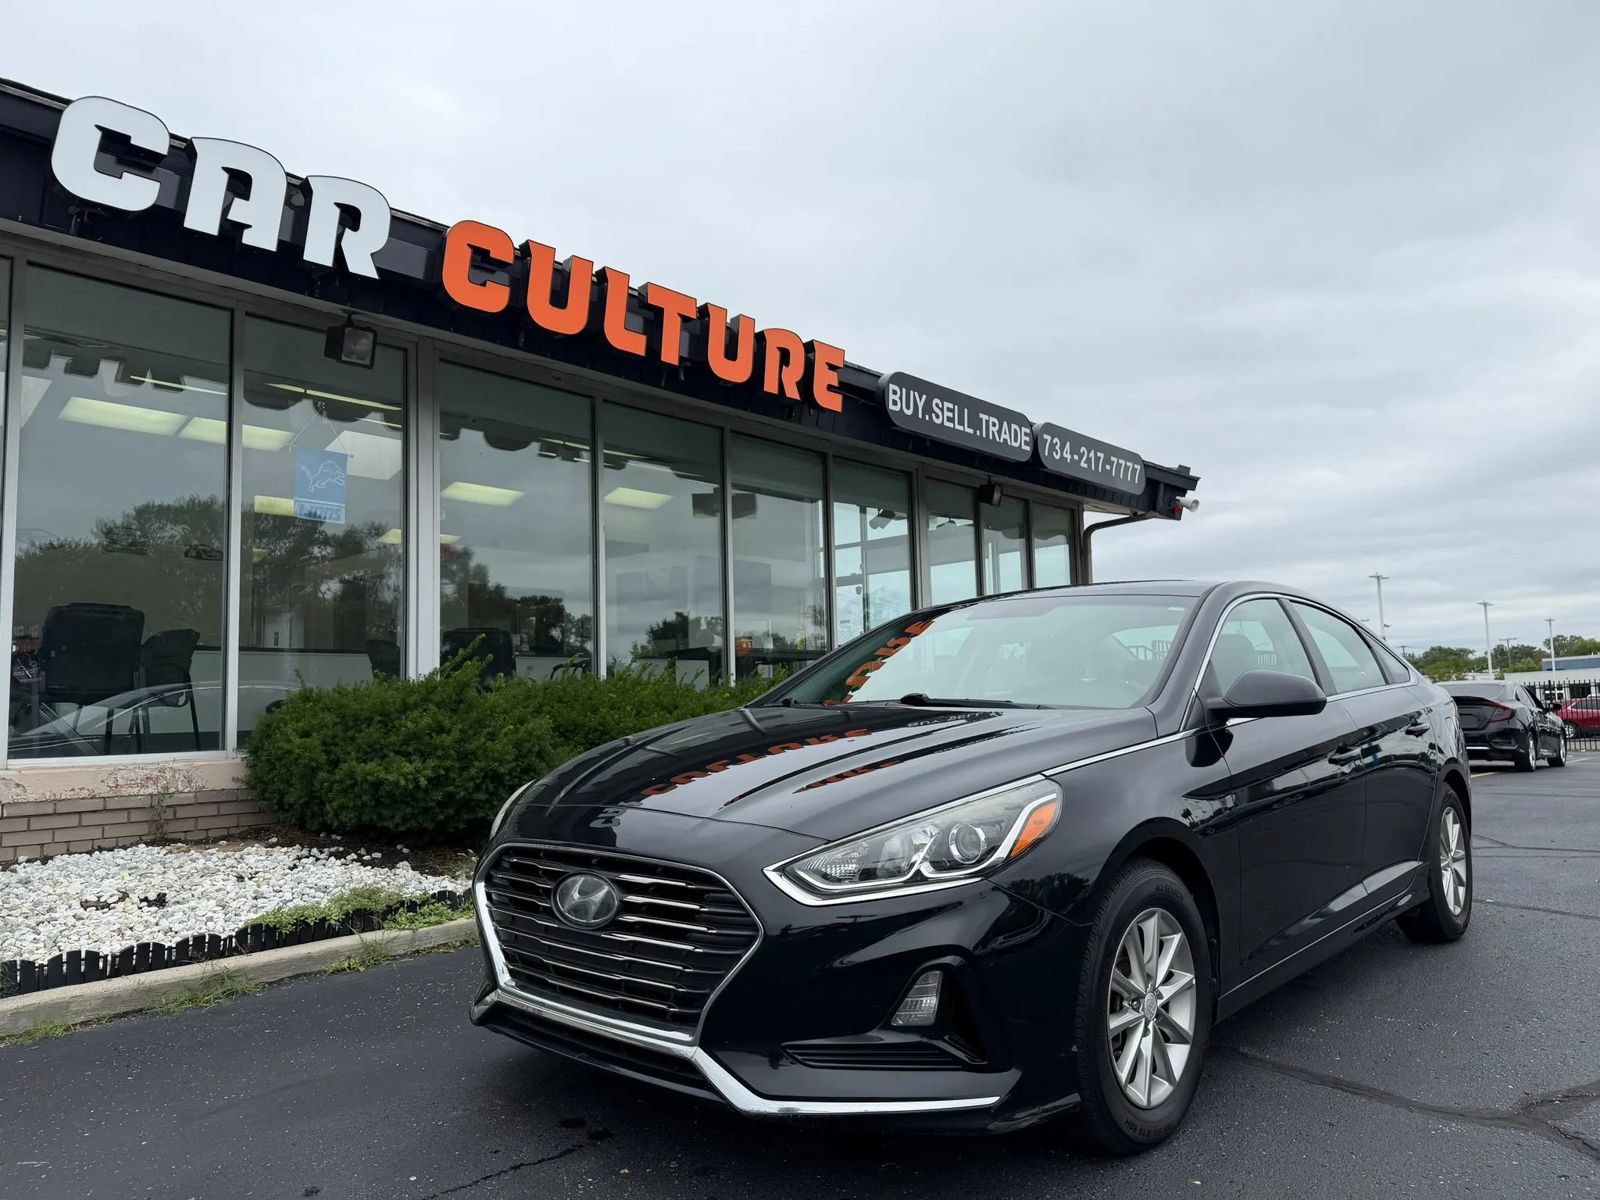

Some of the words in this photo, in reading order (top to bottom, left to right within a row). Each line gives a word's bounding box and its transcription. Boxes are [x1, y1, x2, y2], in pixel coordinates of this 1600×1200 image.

[51, 96, 391, 279] CAR
[442, 220, 846, 413] CULTURE
[1043, 433, 1141, 484] 734-217-7777
